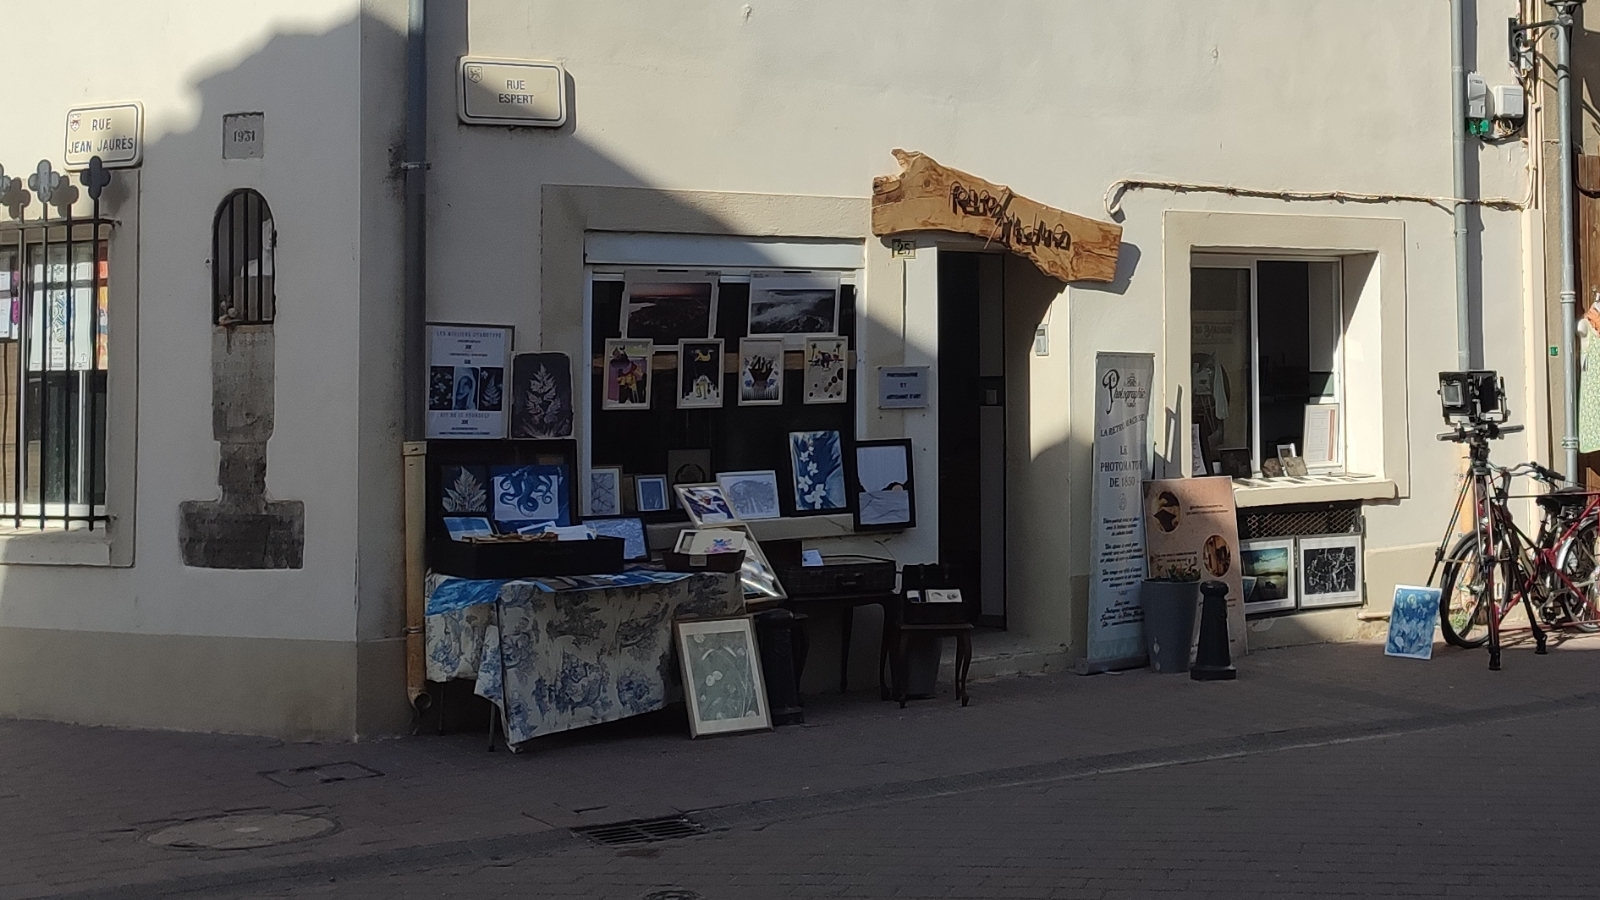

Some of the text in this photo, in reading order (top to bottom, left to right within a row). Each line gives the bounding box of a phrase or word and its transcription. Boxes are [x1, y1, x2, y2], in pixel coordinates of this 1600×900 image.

[507, 80, 526, 90] RUE
[498, 94, 534, 104] ESPERT
[92, 118, 111, 131] RUE
[233, 130, 255, 142] 1931
[68, 135, 134, 154] JEAN JAURÈS
[897, 243, 911, 255] 25
[1100, 428, 1108, 437] LA
[1100, 460, 1143, 472] PHOTOMATON
[1109, 477, 1120, 488] DE
